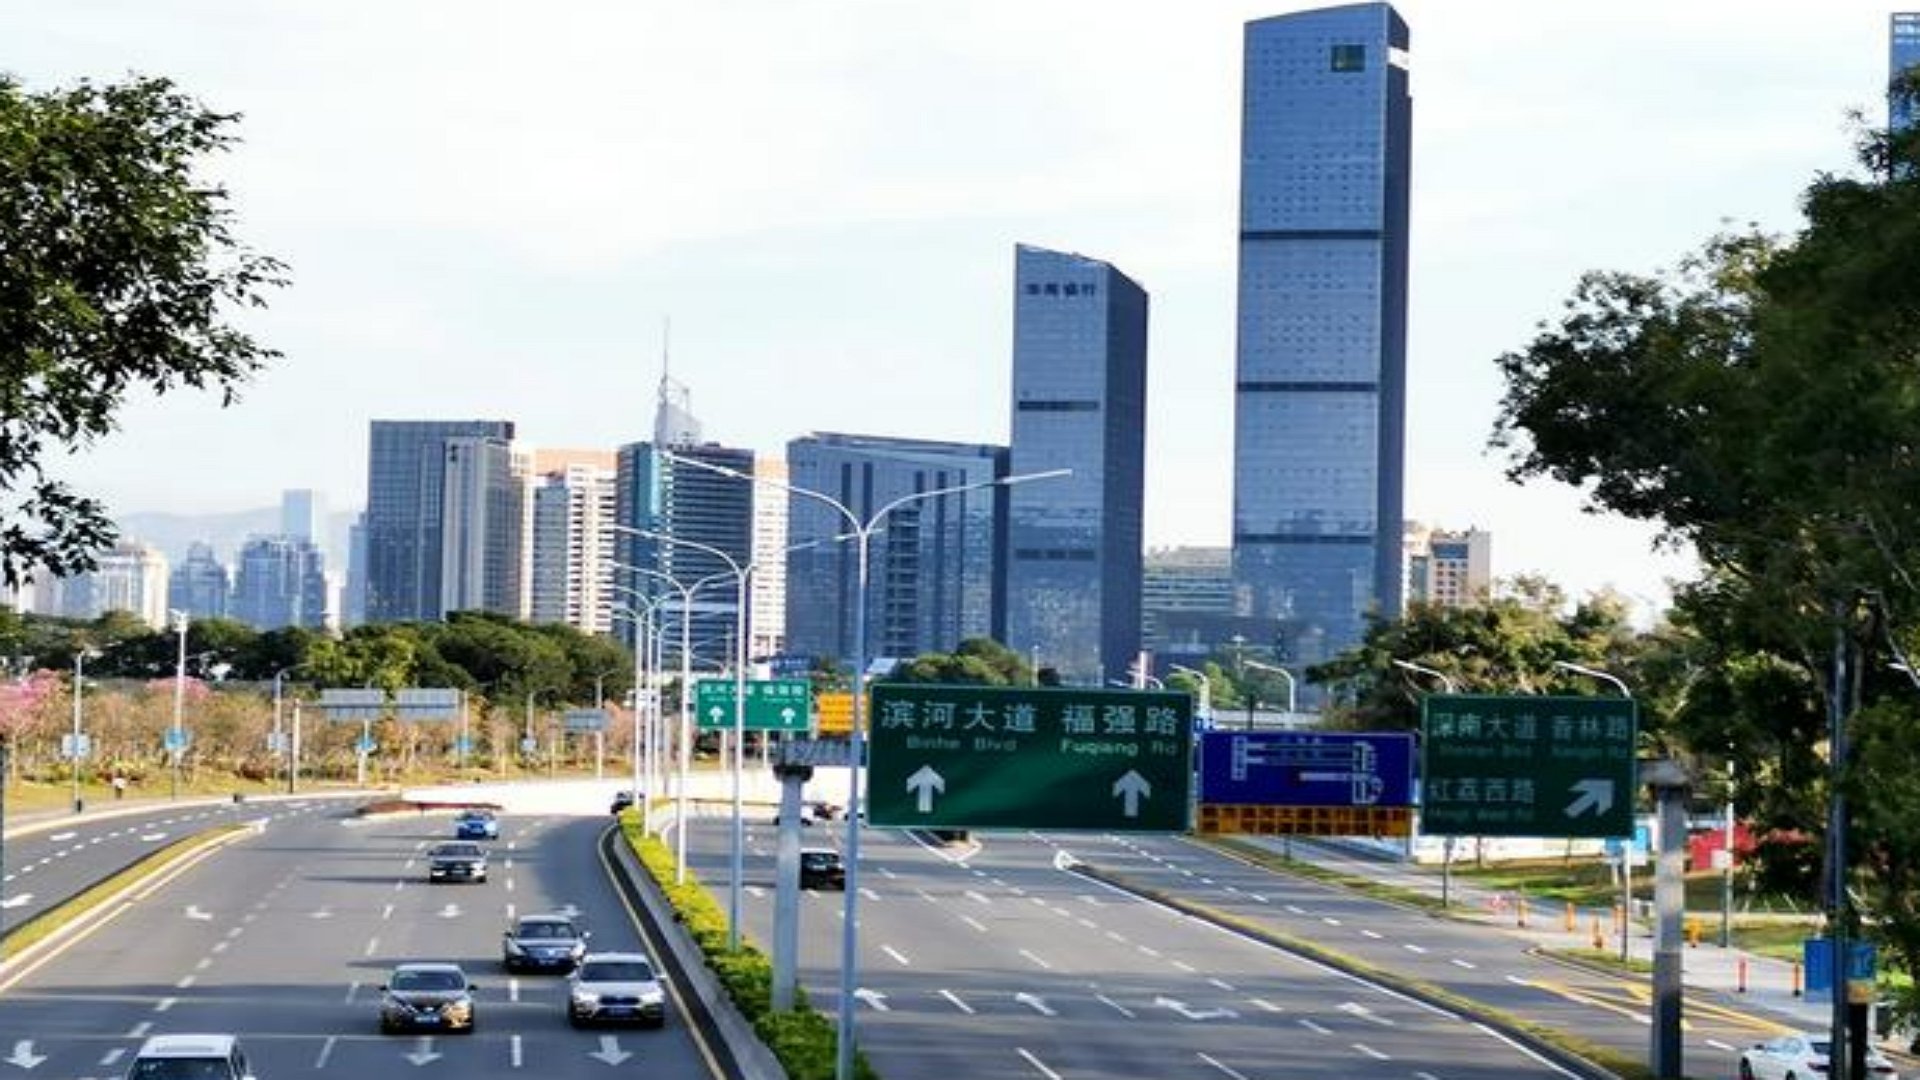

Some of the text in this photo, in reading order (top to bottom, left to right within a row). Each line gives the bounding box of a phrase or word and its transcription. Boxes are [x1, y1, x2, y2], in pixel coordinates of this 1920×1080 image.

[881, 700, 1037, 732] 滨河大道
[1061, 704, 1178, 735] 福强路
